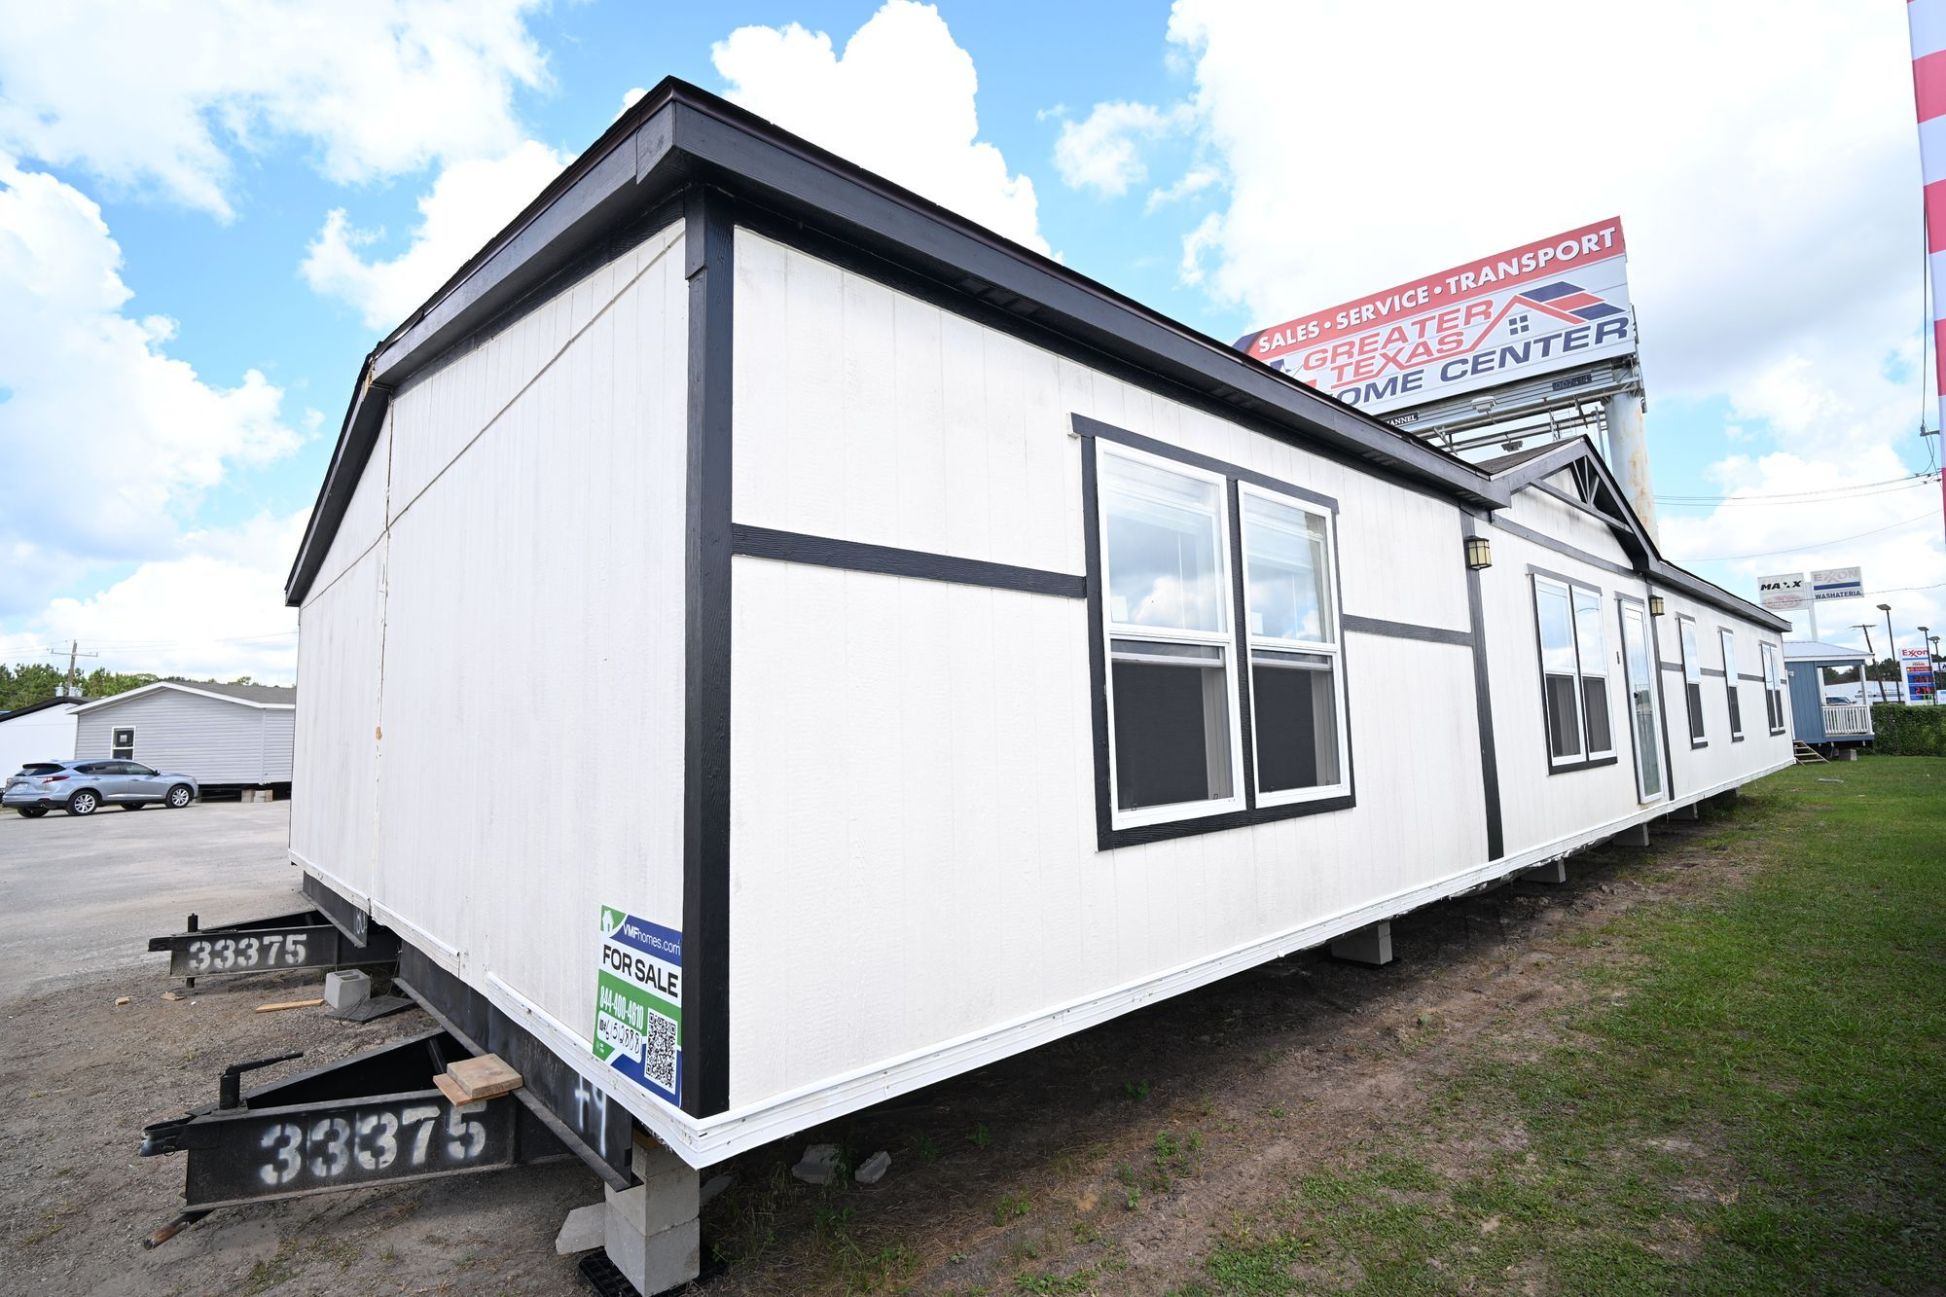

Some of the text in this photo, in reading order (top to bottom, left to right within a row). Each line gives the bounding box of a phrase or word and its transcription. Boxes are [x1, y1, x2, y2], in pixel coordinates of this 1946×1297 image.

[1258, 227, 1617, 353] SALES SERVICE TRANSPORT
[1303, 299, 1494, 371] GREATER
[1329, 317, 1630, 406] OME CENTER
[1331, 331, 1465, 383] TEXAS
[1815, 590, 1861, 599] WASHATERIA
[189, 933, 307, 971] 33375
[603, 944, 679, 998] FOR SALE
[260, 1100, 488, 1186] 33375
